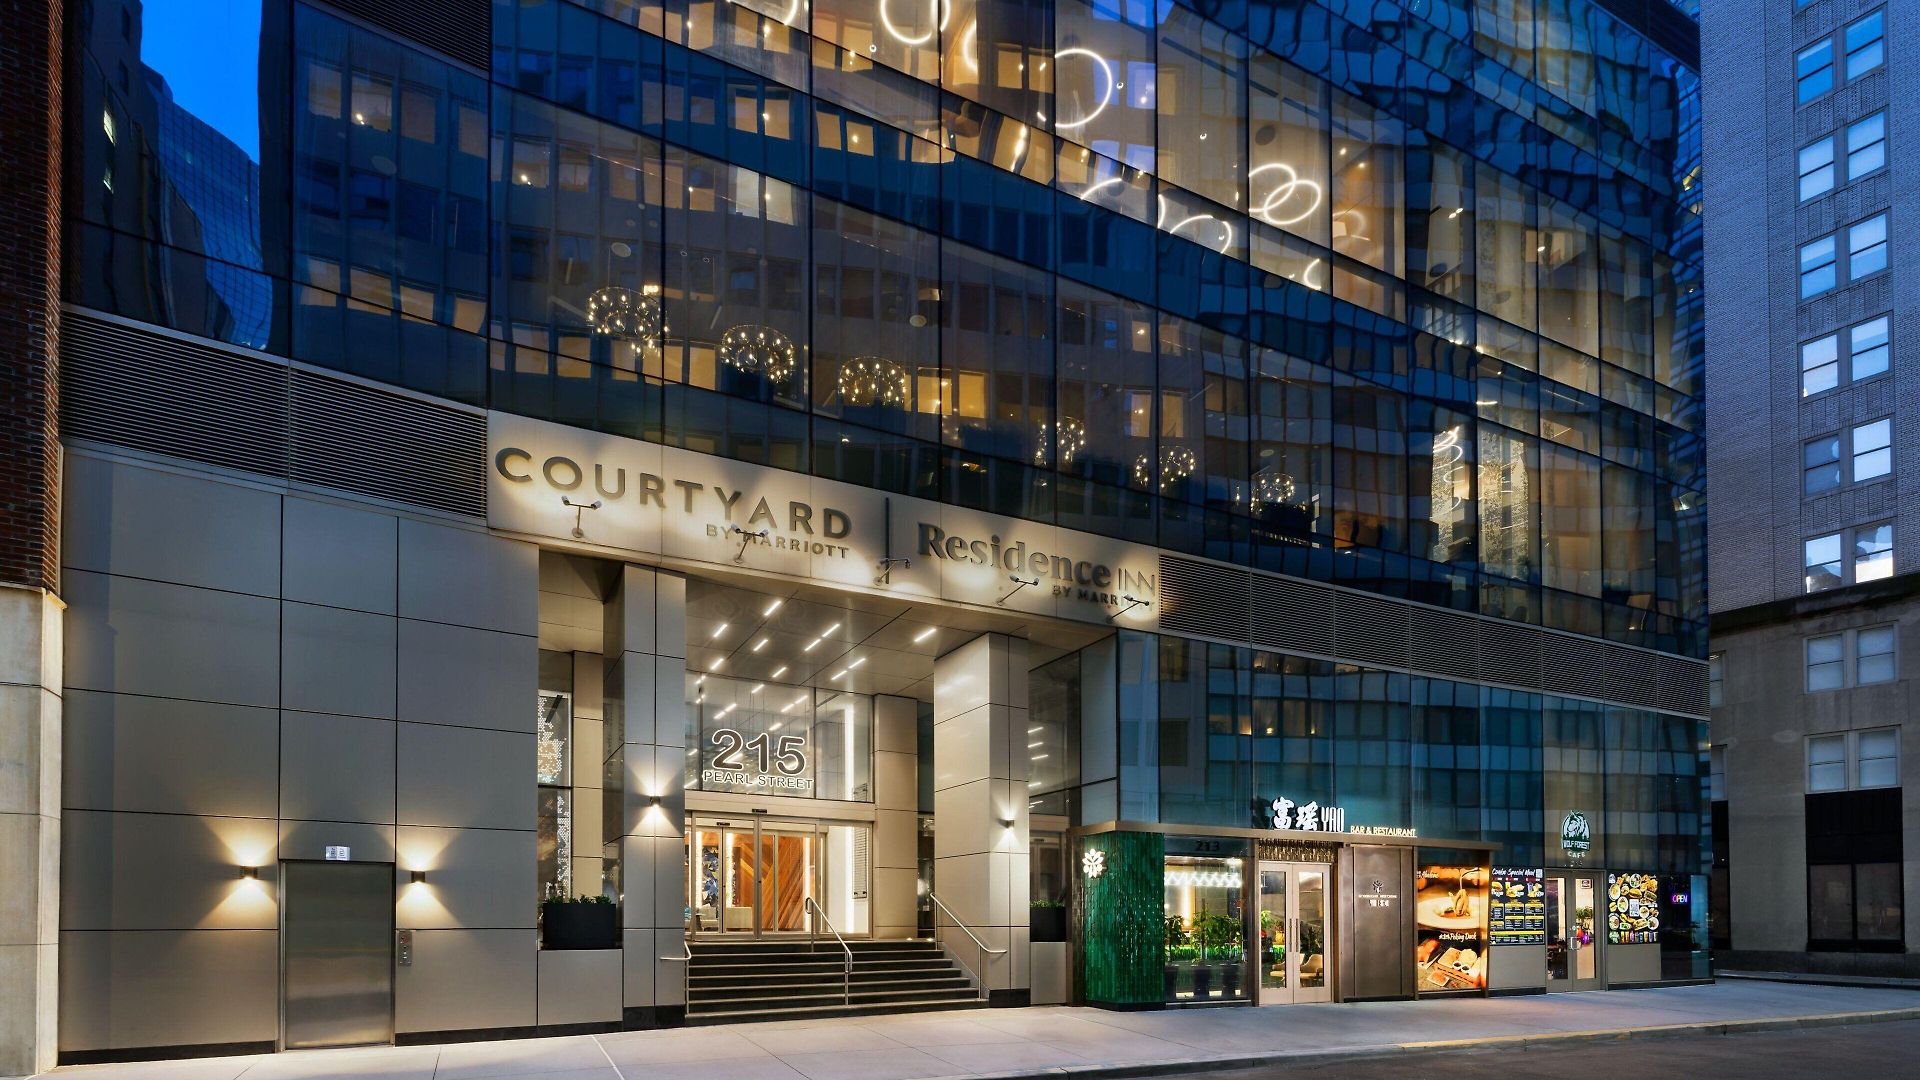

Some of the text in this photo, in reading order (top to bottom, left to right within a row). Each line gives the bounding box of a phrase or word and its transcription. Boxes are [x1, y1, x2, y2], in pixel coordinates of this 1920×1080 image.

[495, 447, 852, 539] COURTYARD
[706, 523, 850, 559] BY MARRIOTT
[917, 522, 1157, 597] Residence INN
[1052, 585, 1072, 599] BY
[711, 728, 807, 776] 215
[702, 770, 814, 790] PEARL STREET
[1320, 806, 1345, 833] YAO
[1350, 825, 1416, 838] BAR & RESTAURANT
[1195, 837, 1220, 852] 213
[1672, 894, 1688, 903] OPEN
[1464, 931, 1477, 941] Duck
